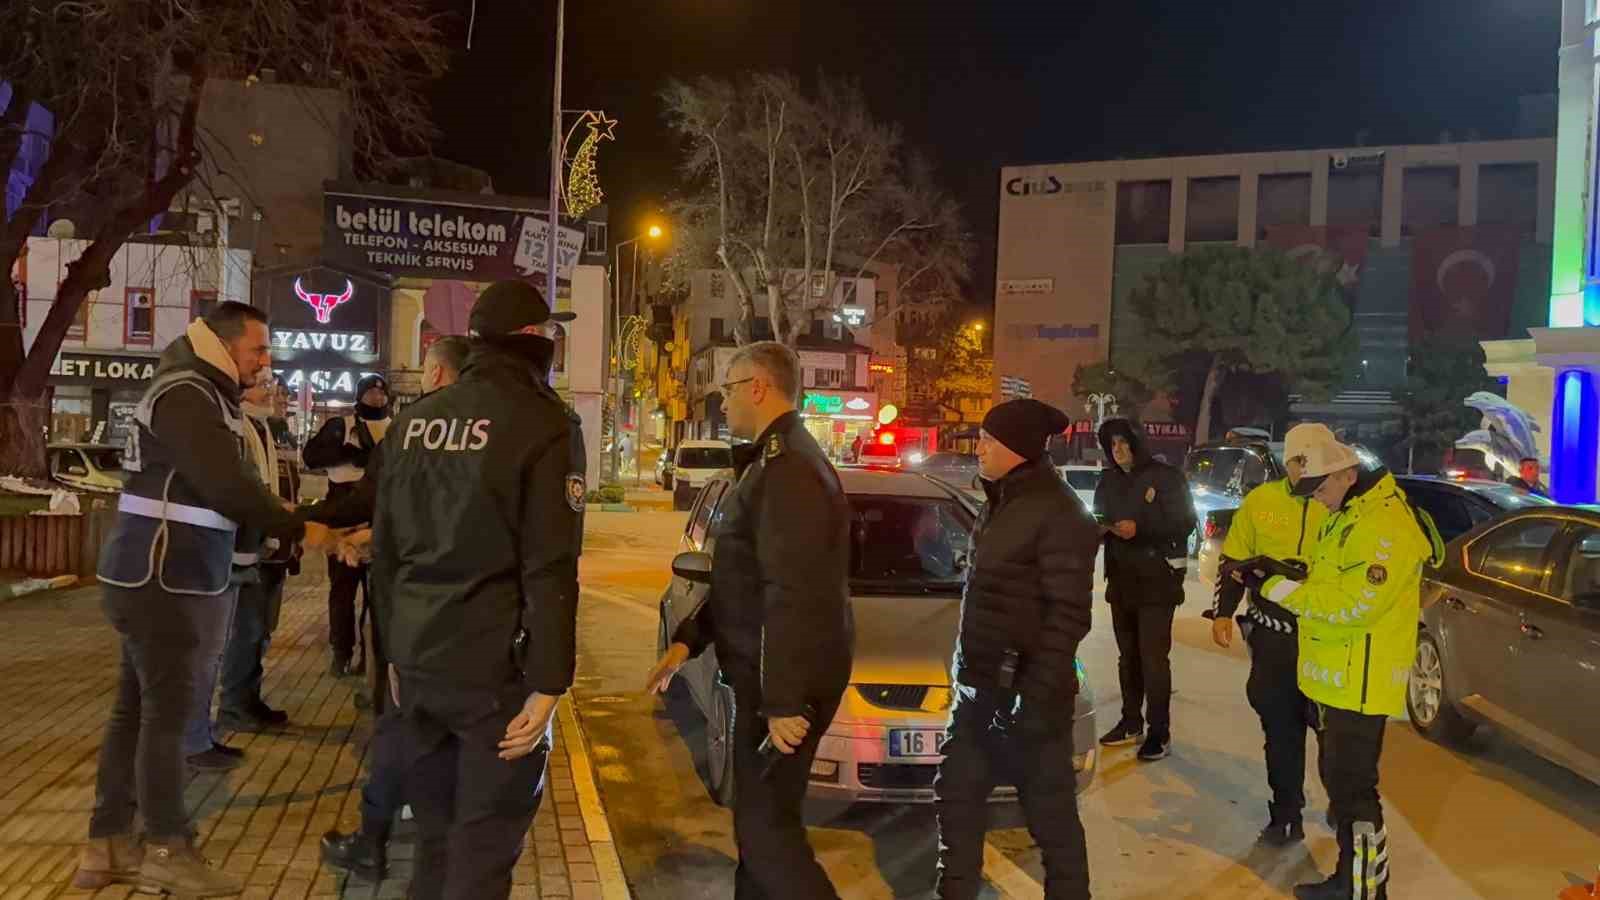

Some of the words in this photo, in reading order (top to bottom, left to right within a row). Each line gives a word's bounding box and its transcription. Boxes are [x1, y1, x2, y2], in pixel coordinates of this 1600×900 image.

[336, 205, 400, 233] betül
[409, 211, 506, 242] telekom
[344, 233, 408, 249] TELEFON
[423, 240, 499, 257] AKSESUAR
[368, 251, 421, 267] TEKNİK
[426, 256, 474, 271] SERVİS
[275, 331, 368, 351] YAVUZ
[903, 732, 924, 753] 16
